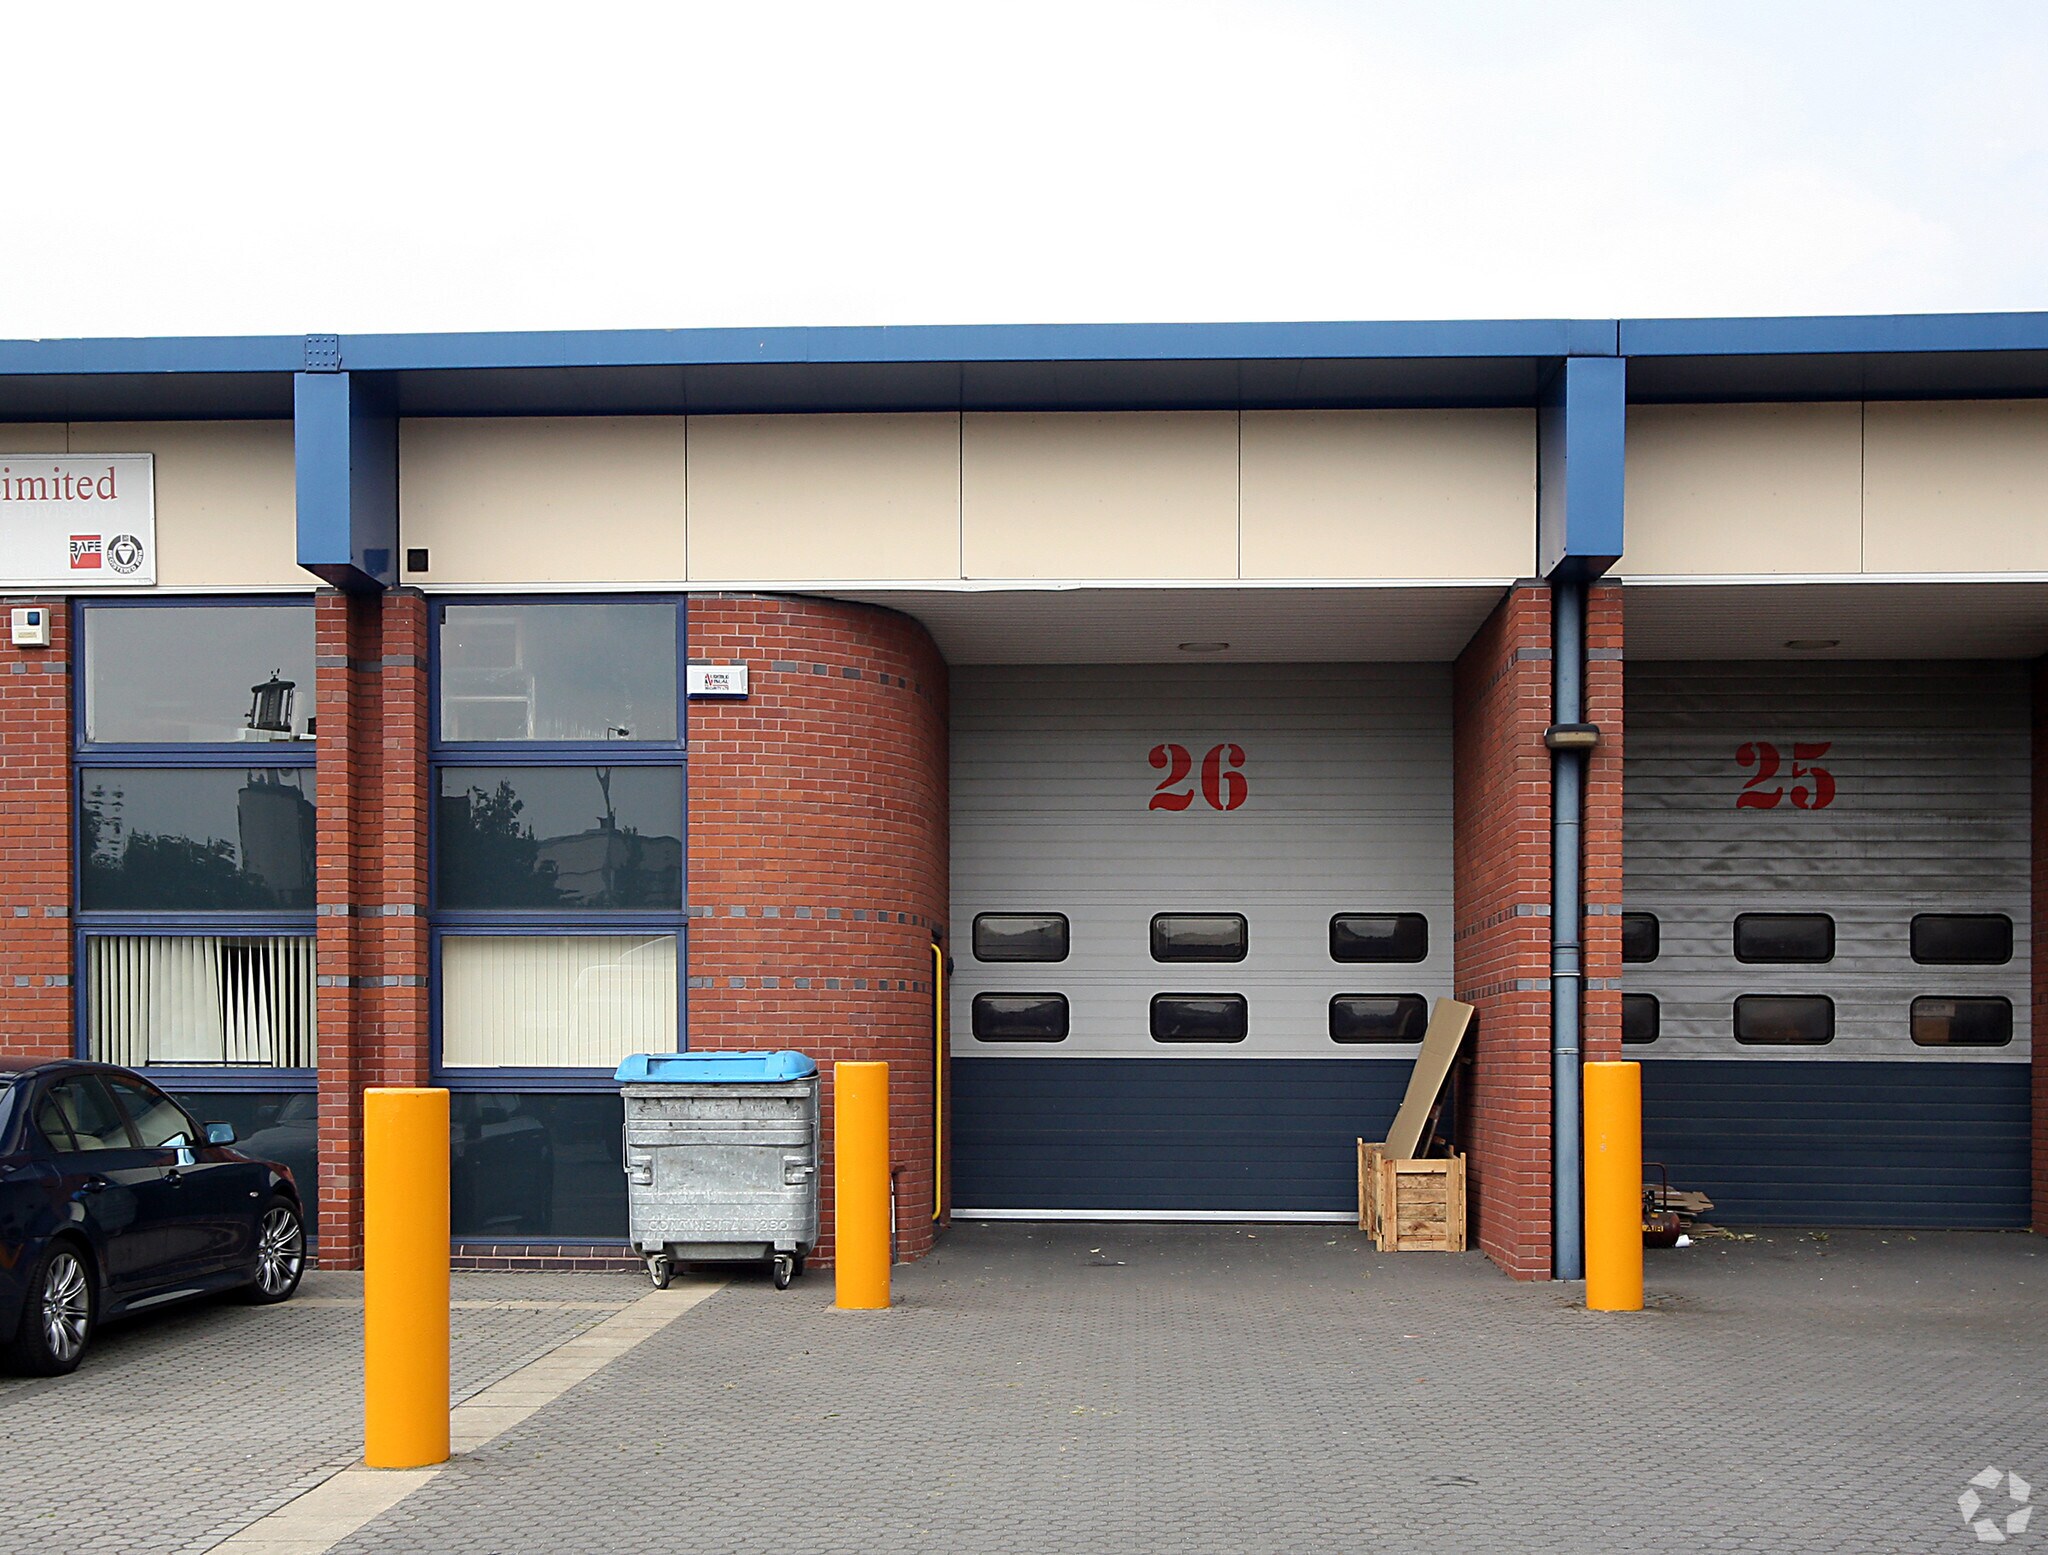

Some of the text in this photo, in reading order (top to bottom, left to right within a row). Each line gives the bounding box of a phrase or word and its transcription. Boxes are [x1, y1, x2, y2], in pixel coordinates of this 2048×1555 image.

[0, 466, 117, 500] imited
[70, 541, 101, 557] BAFE
[1148, 743, 1248, 811] 26
[1735, 741, 1835, 810] 25
